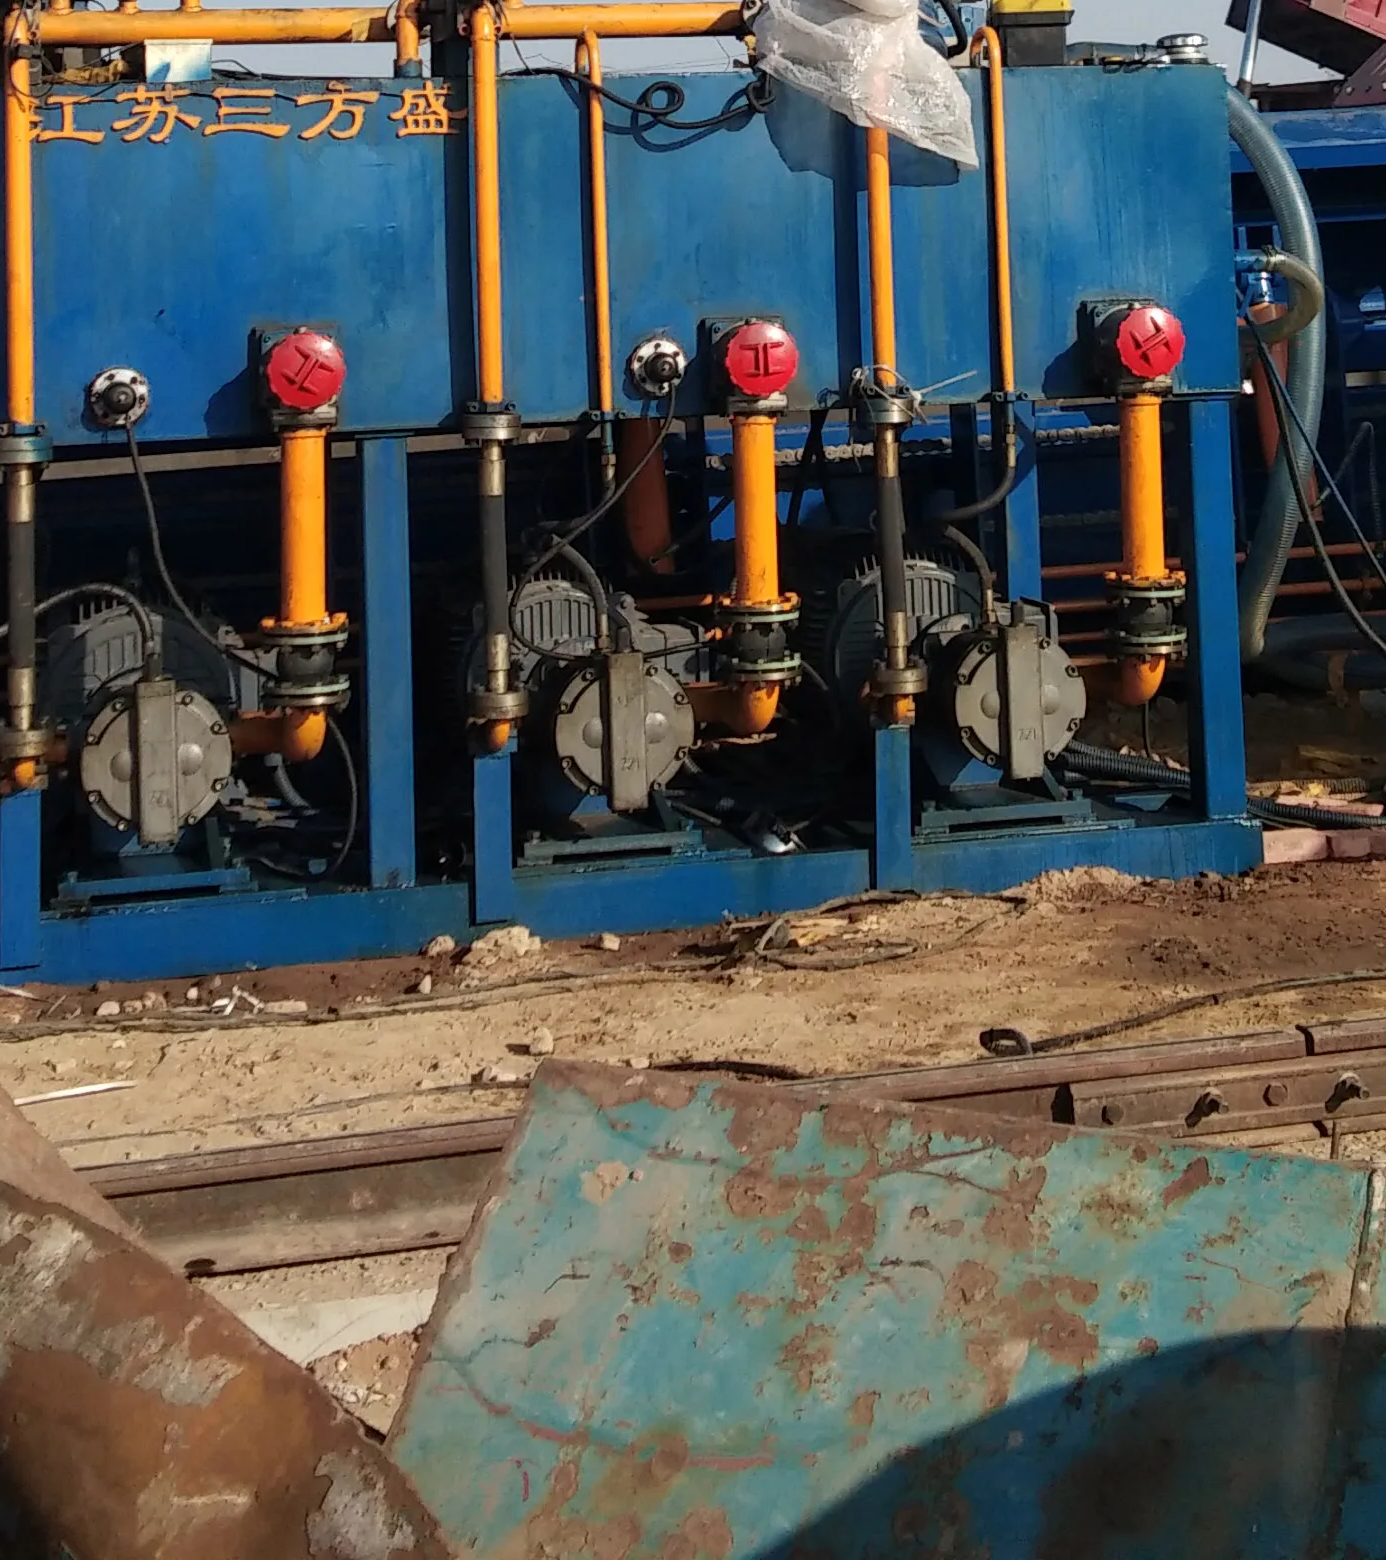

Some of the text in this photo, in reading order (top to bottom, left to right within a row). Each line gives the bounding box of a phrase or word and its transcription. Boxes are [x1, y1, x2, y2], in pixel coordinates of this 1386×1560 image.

[27, 81, 467, 144] 江苏三方盛
